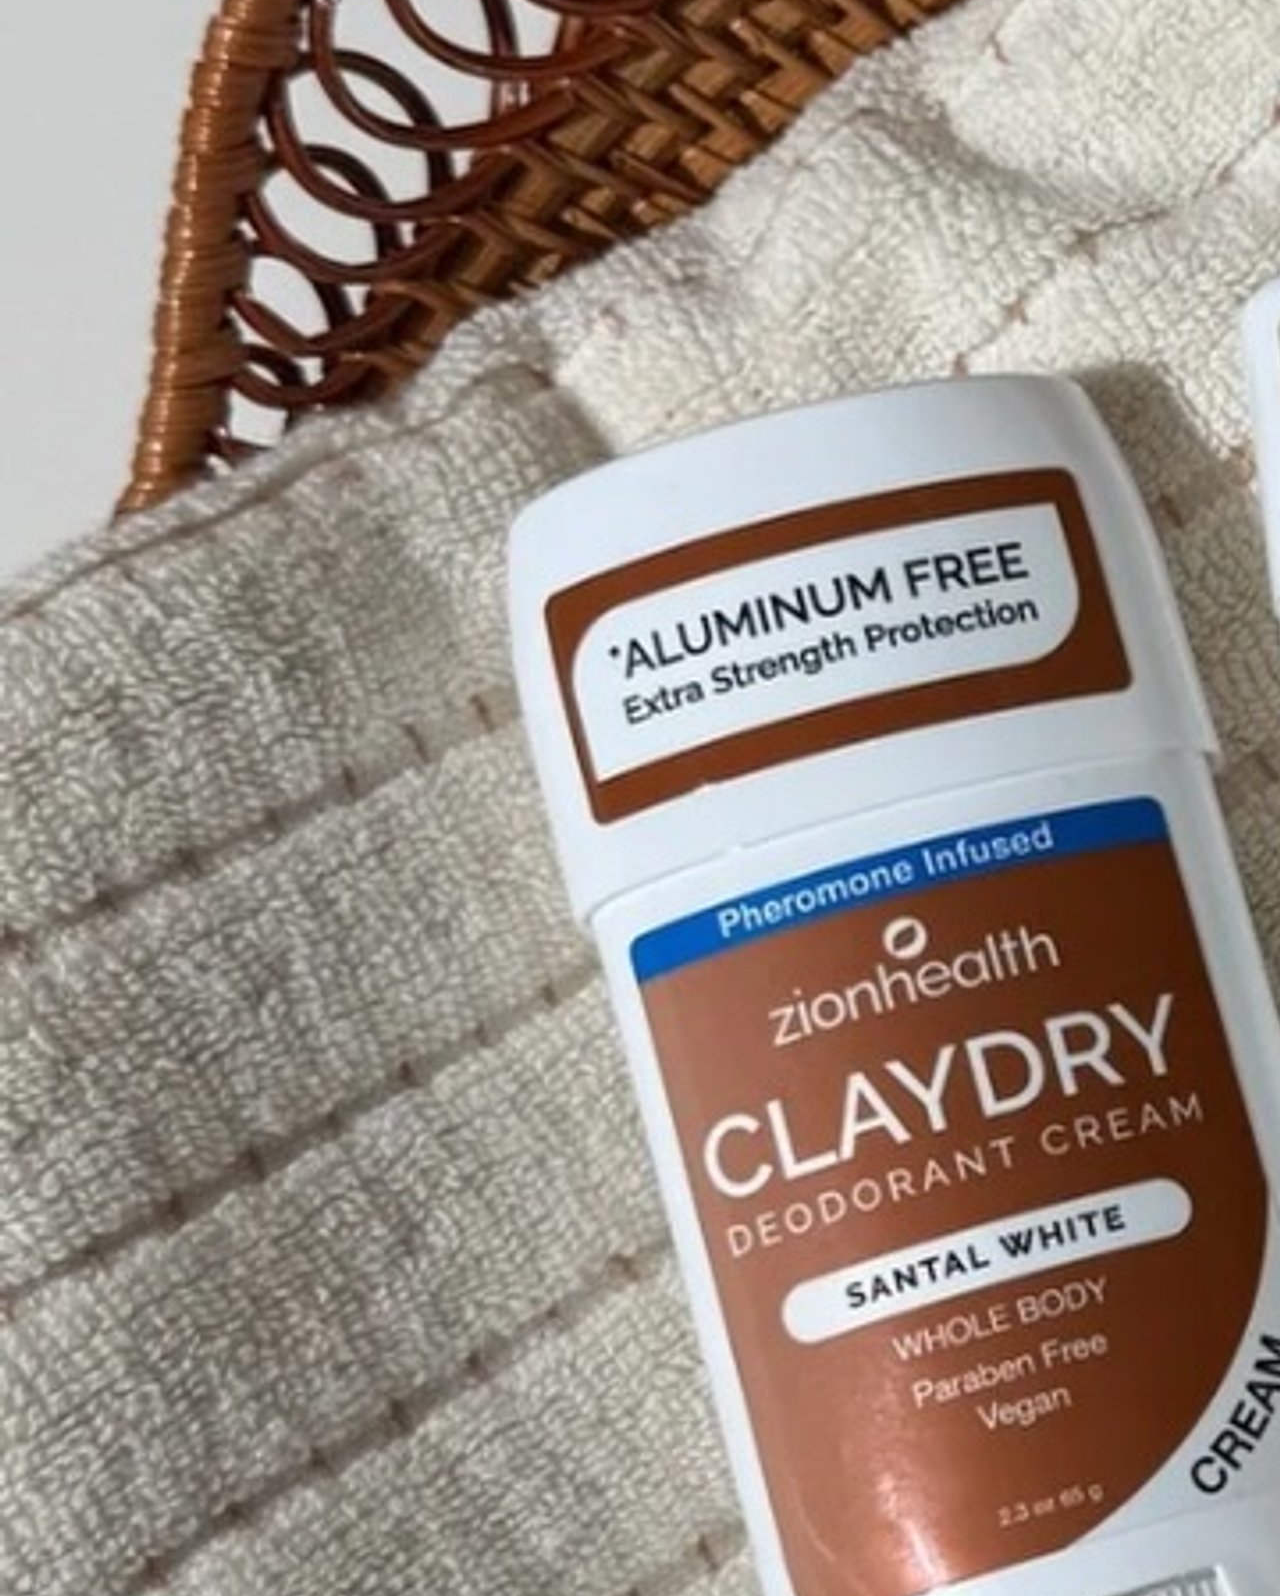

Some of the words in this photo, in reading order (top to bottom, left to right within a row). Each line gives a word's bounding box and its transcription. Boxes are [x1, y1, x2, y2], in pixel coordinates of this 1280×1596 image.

[906, 543, 1030, 600] FREE
[622, 681, 705, 725] Extra
[711, 632, 858, 696] Strength
[865, 598, 1039, 653] Protection
[718, 859, 914, 938] Pheromone
[922, 823, 1054, 878] Infused
[768, 926, 1059, 1047] zionhealth
[703, 993, 1176, 1199] CLAYDRY
[727, 1135, 1017, 1258] DEODORANT
[1040, 1093, 1205, 1157] CREAM
[845, 1246, 991, 1309] SANTAL
[999, 1205, 1126, 1259] WHITE
[891, 1310, 1010, 1362] WHOLE
[1017, 1277, 1109, 1325] BODY
[911, 1347, 1035, 1408] Paraben
[1041, 1331, 1109, 1372] Free
[976, 1386, 1071, 1432] Vegan
